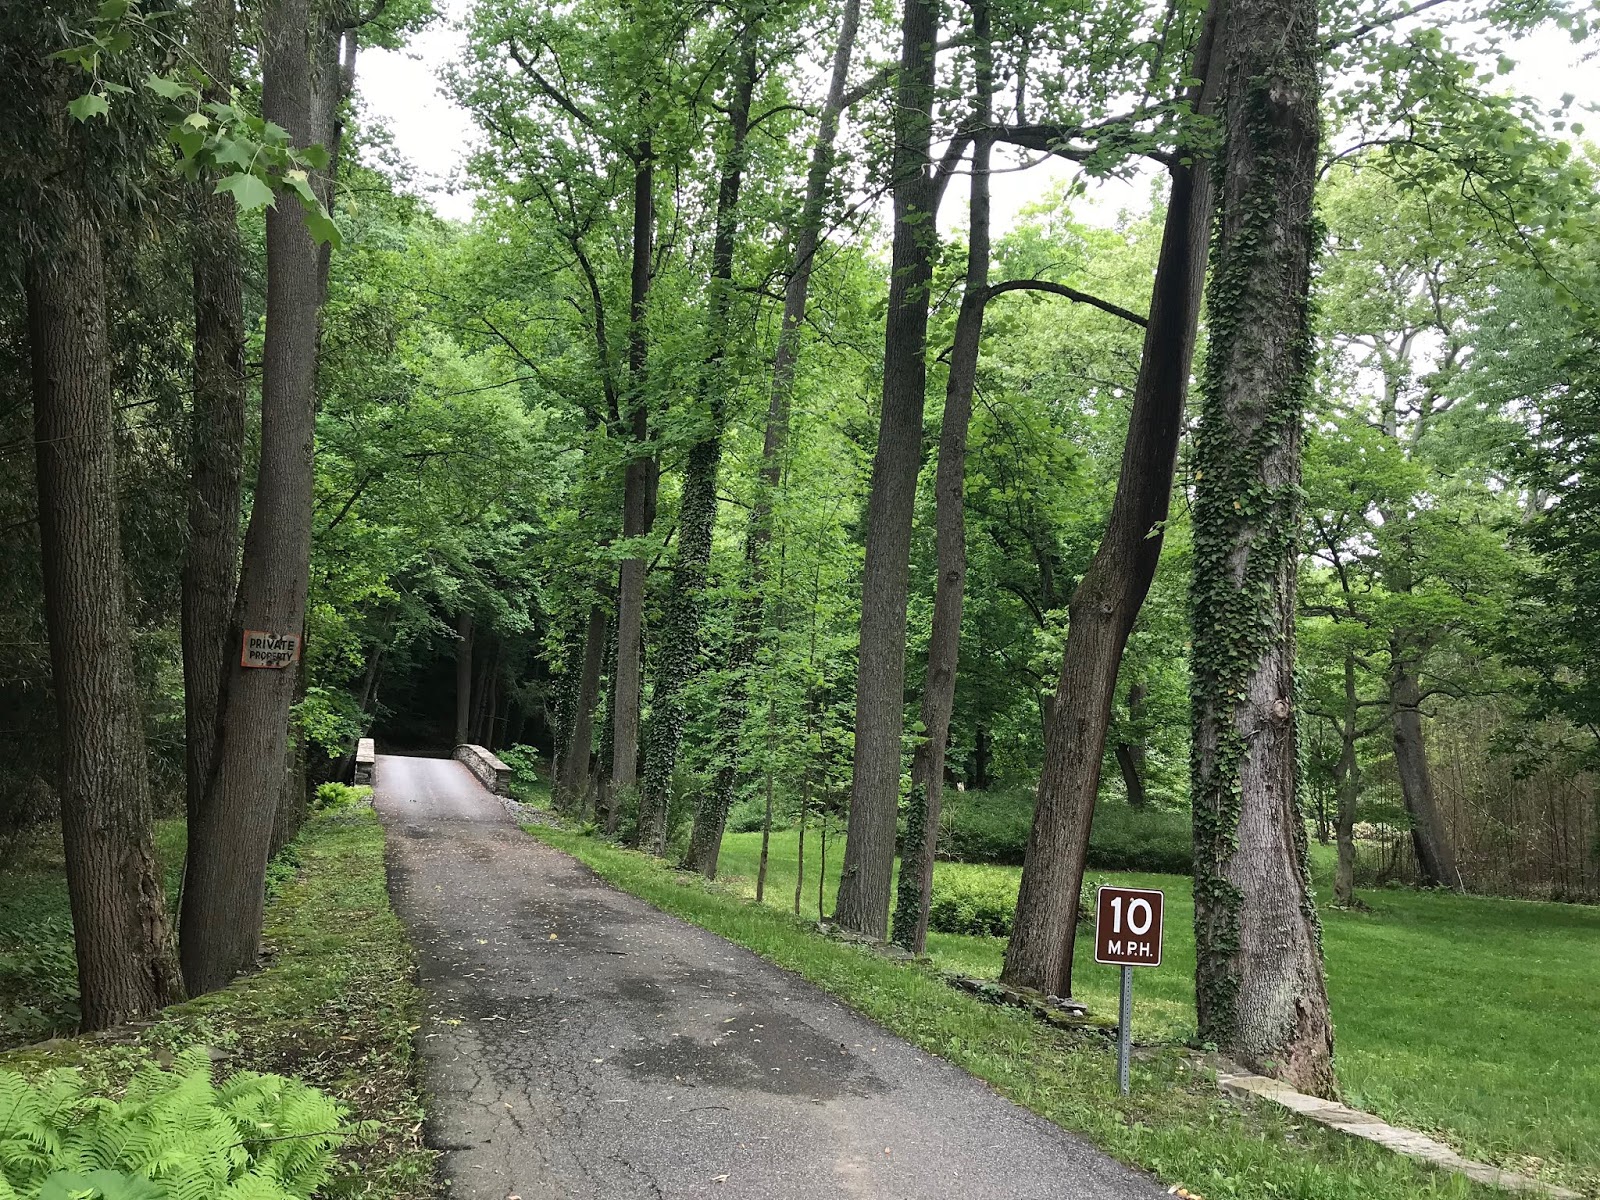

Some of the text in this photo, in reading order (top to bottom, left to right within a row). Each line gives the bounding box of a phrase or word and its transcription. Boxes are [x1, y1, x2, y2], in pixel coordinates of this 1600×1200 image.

[249, 638, 295, 650] PRIVATE
[249, 650, 293, 661] PROPERTY
[1111, 897, 1153, 935] 10
[1108, 939, 1153, 957] M.P.H.
